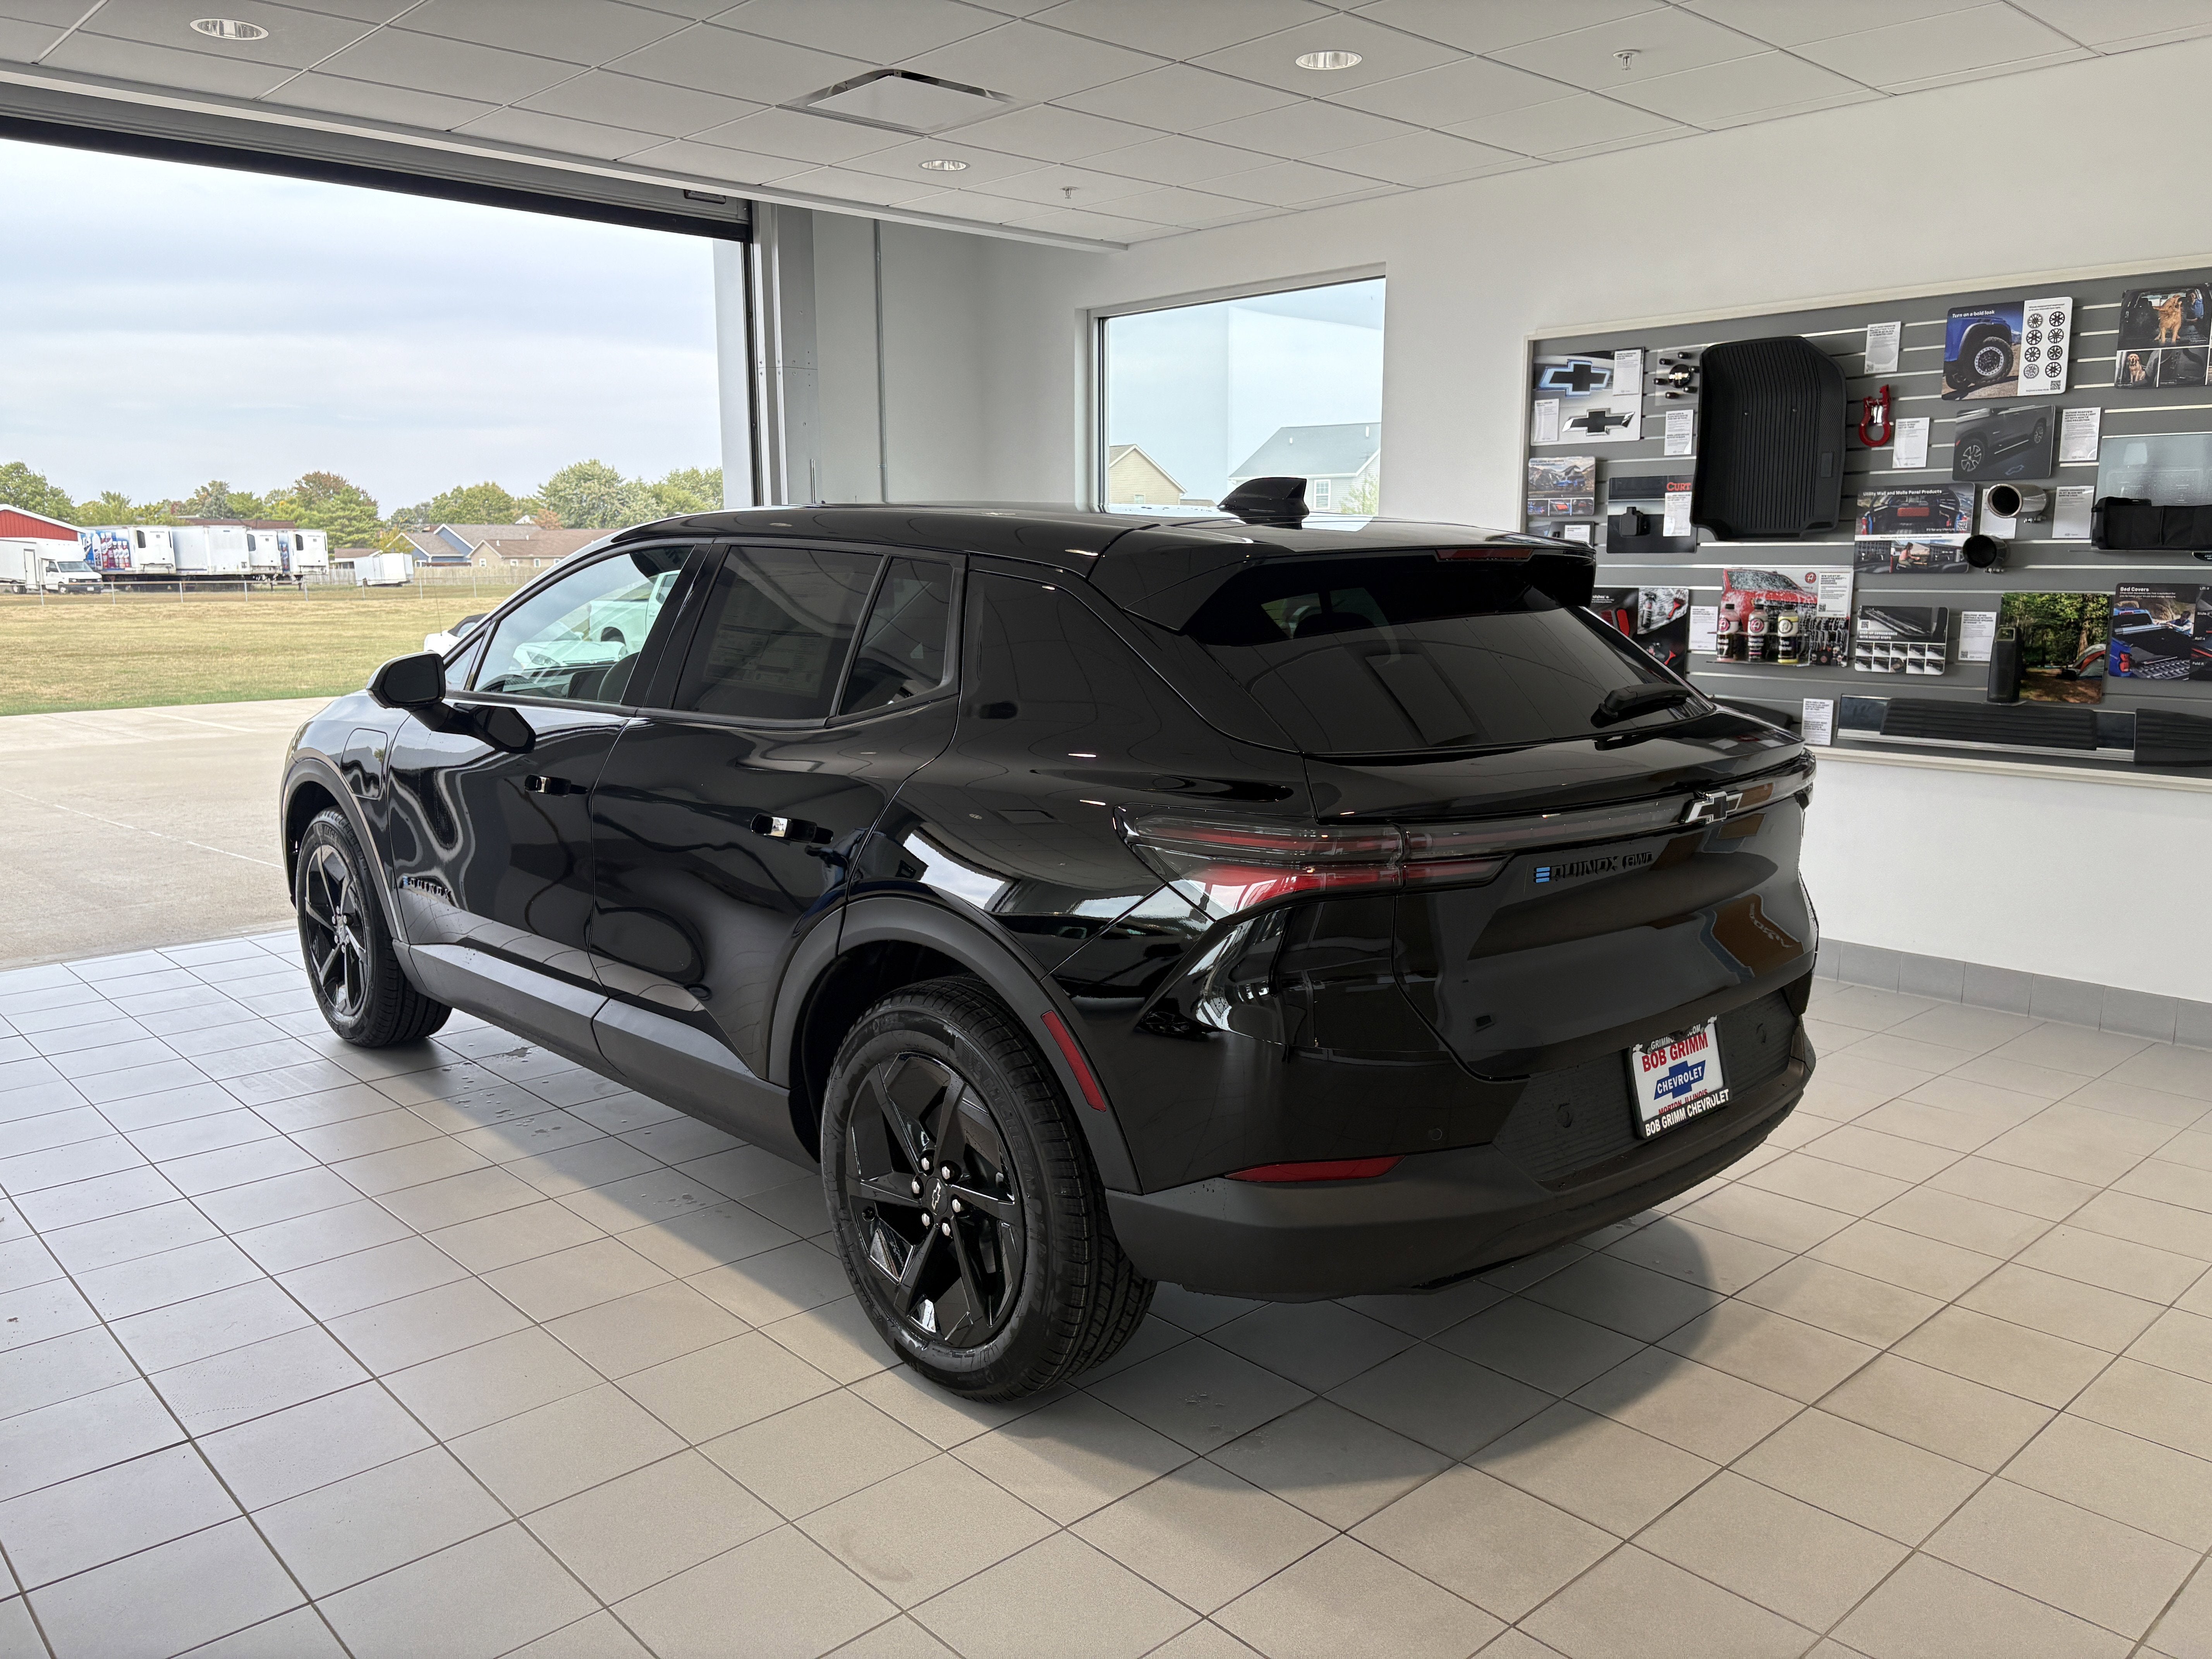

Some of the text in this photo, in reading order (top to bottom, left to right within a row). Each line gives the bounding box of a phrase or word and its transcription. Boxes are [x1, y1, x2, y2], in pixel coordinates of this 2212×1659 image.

[1666, 482, 1692, 491] CURT
[1534, 856, 1619, 883] EQUINOX
[1642, 1032, 1708, 1072] BOB GRIMM
[1657, 1066, 1702, 1094] CHEVROLET
[1685, 1089, 1708, 1104] ILLINOIS
[1645, 1089, 1729, 1137] BOB GRIMM CHEVROLET
